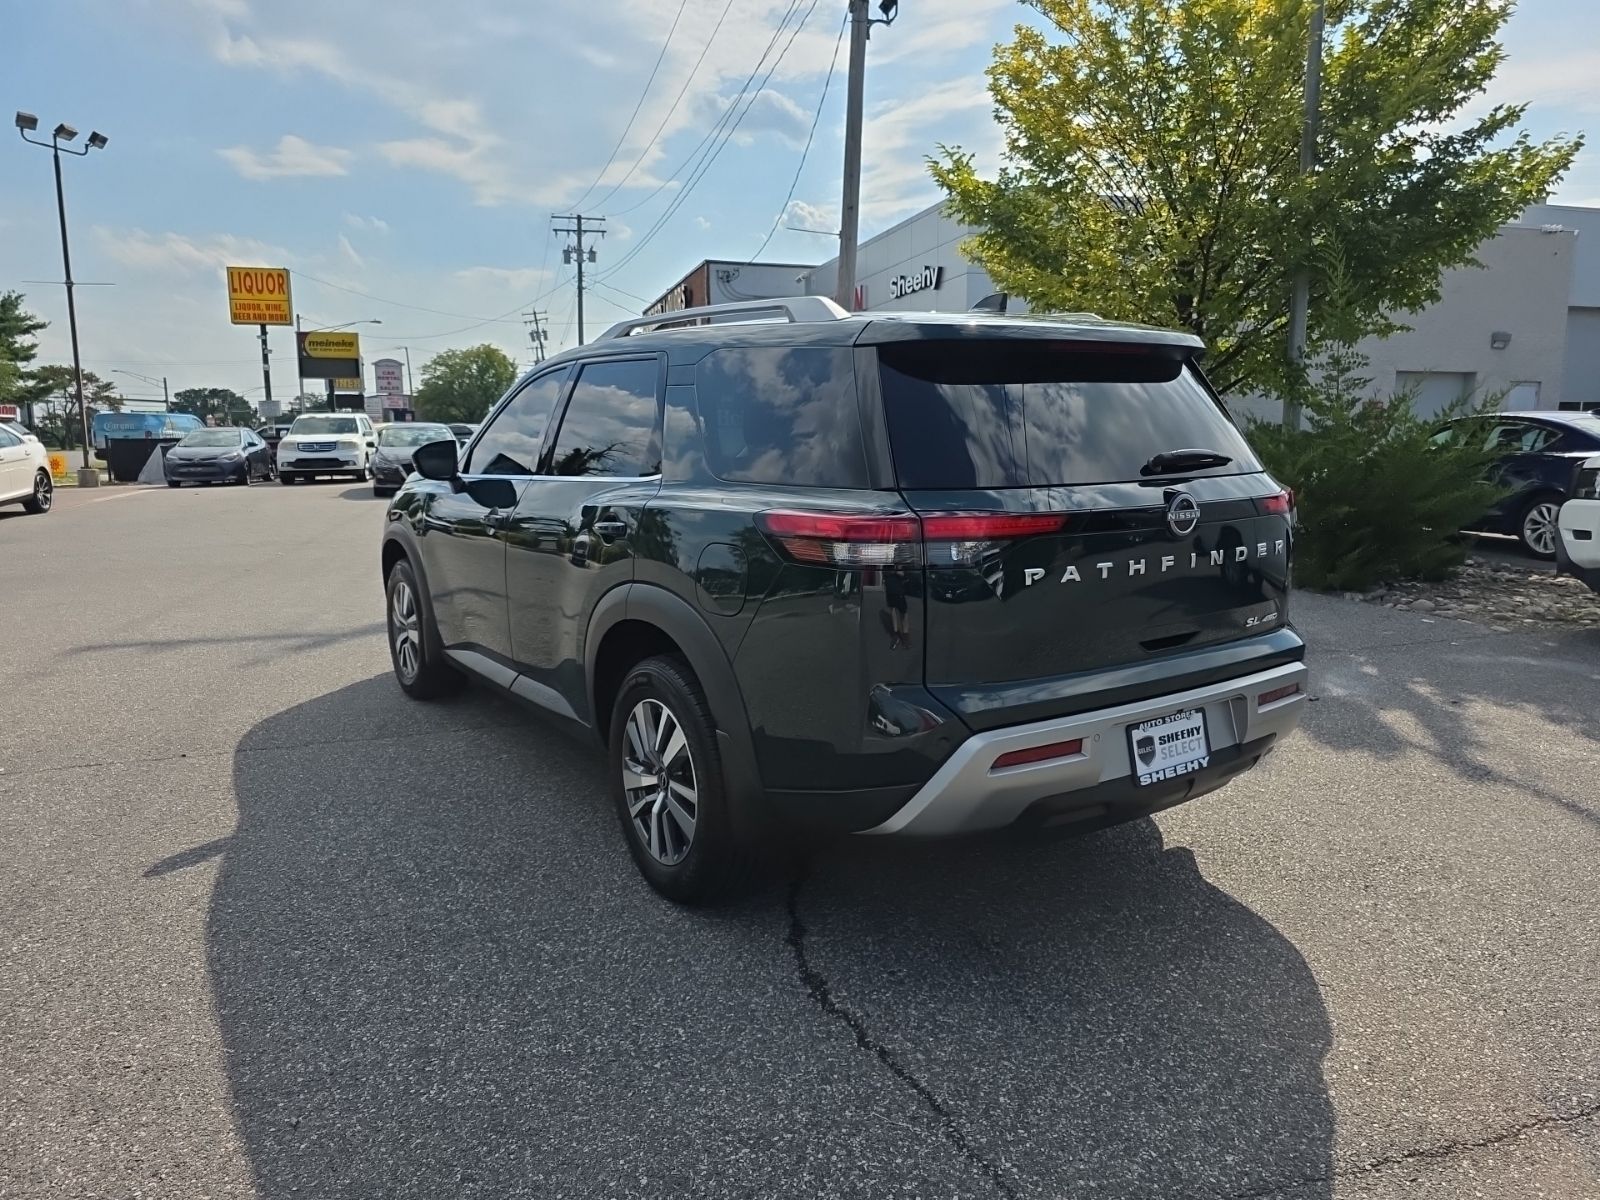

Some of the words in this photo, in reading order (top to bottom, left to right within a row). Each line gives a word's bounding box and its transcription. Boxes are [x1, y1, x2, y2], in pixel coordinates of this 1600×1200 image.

[230, 271, 286, 295] LIQUOR
[889, 264, 940, 299] Sheehy
[233, 312, 251, 321] BEER
[252, 312, 267, 321] AND
[268, 313, 288, 321] MORE
[308, 339, 354, 348] meineke
[1167, 509, 1201, 521] NISSAN
[1023, 539, 1284, 586] PATHFINDER
[1245, 616, 1260, 627] SL
[1139, 717, 1163, 730] AUTO
[1158, 725, 1202, 746] SHEEHY
[1161, 737, 1203, 760] SELECT
[1139, 756, 1210, 786] SHEEHY
